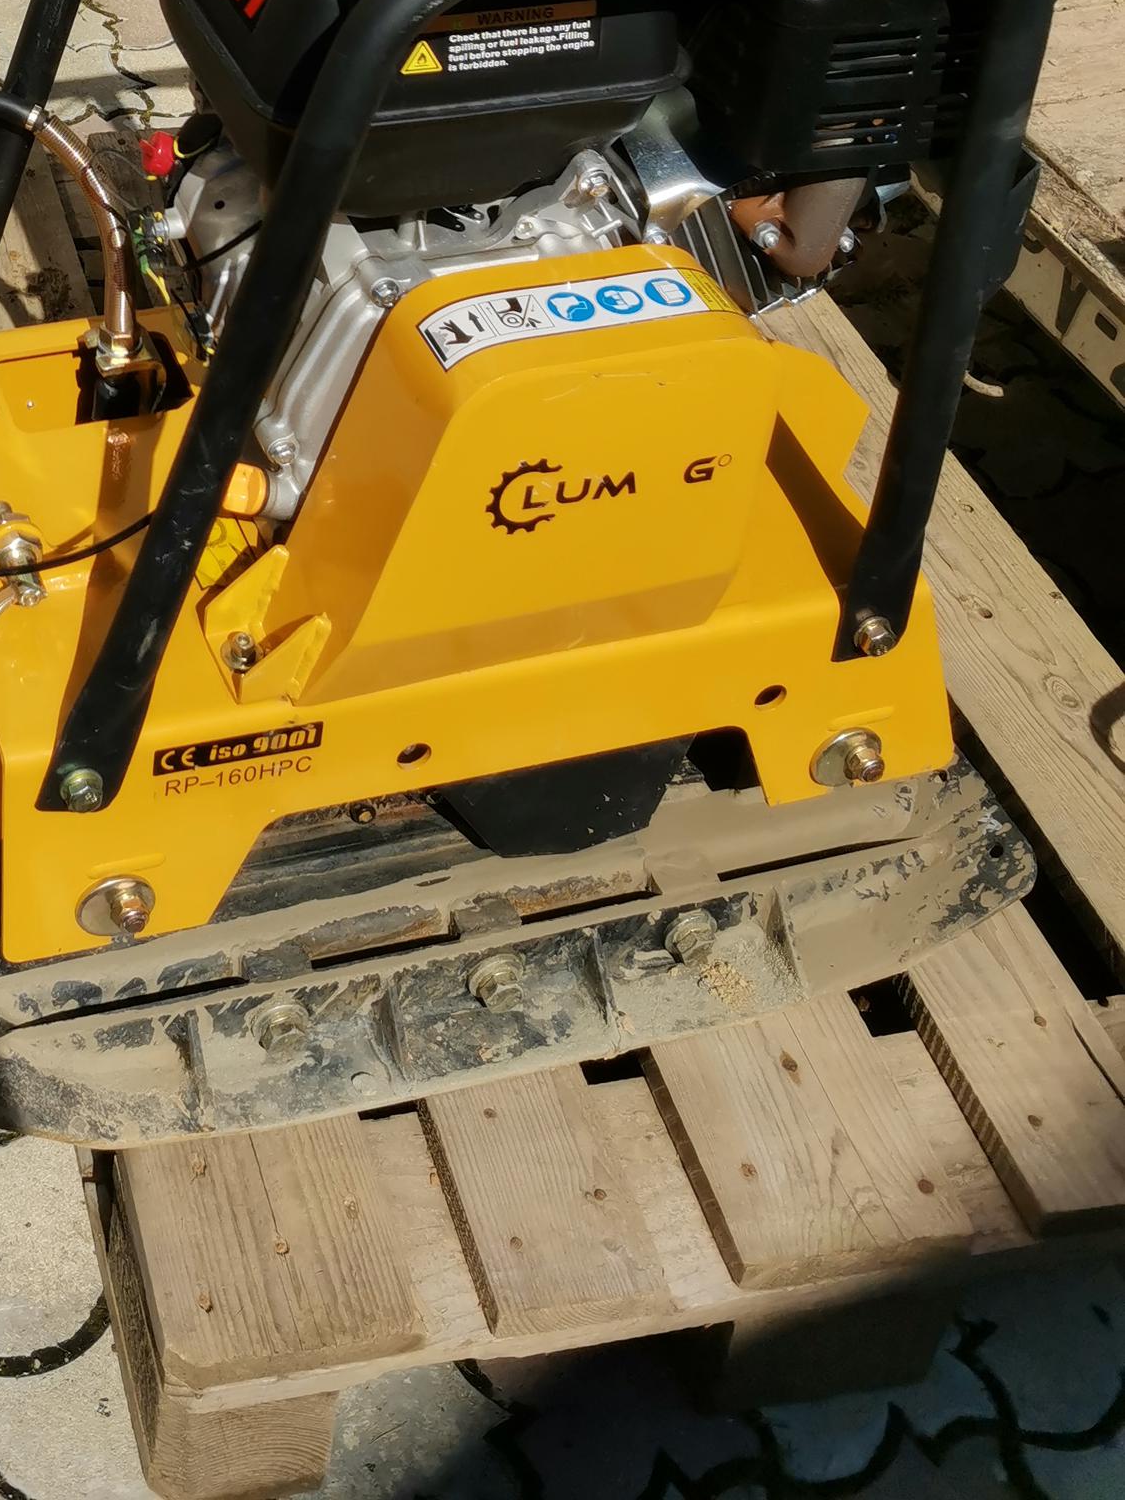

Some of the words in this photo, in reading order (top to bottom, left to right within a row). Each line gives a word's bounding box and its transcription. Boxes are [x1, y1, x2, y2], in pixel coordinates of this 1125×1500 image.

[477, 7, 555, 25] WARNING
[448, 33, 480, 43] Check
[481, 30, 501, 39] that
[502, 28, 528, 38] there
[529, 26, 538, 35] is
[539, 26, 552, 34] no
[553, 23, 570, 33] any
[572, 20, 591, 30] fuel
[448, 42, 486, 54] spilling
[487, 41, 498, 49] or
[499, 38, 518, 47] fuel
[448, 53, 468, 63] fuel
[469, 49, 501, 61] before
[502, 45, 545, 57] stopping
[546, 43, 562, 52] the
[562, 39, 595, 51] engine
[448, 63, 457, 72] is
[459, 58, 509, 71] forbidden.
